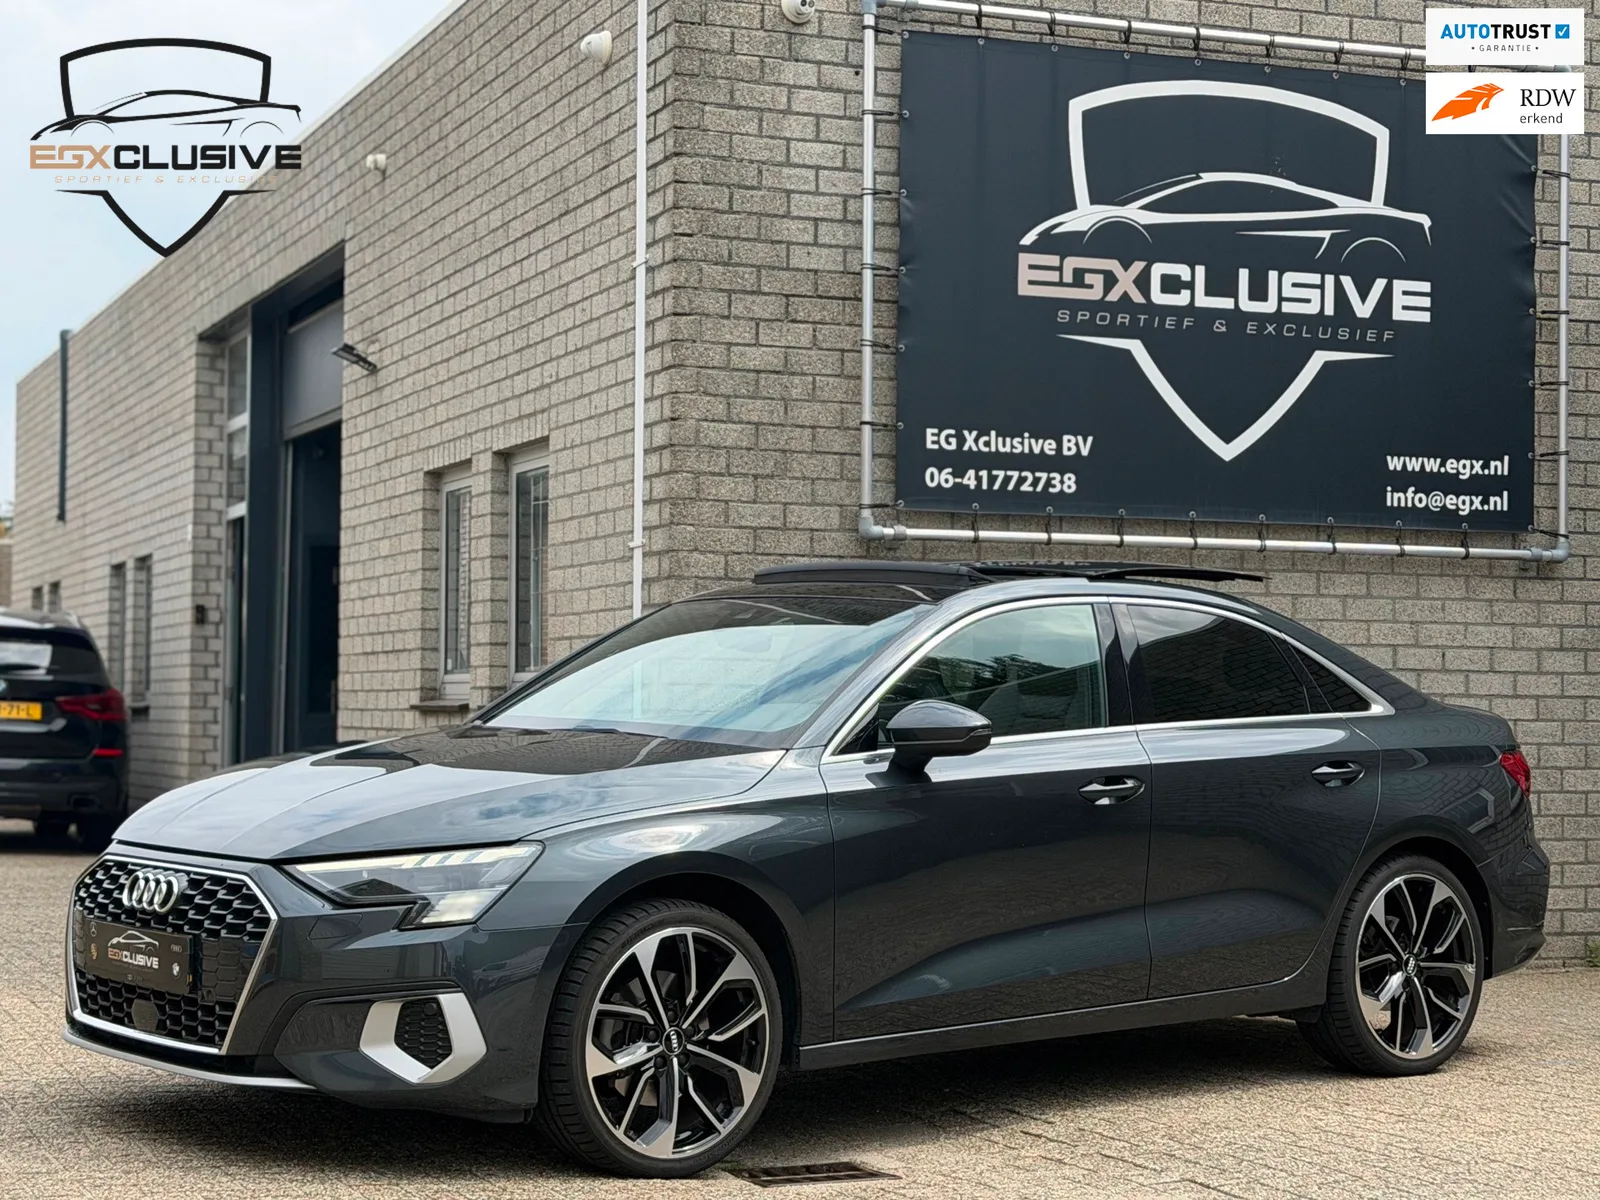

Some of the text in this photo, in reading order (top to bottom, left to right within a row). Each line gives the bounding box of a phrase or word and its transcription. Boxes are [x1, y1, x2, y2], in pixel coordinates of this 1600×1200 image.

[1017, 252, 1432, 323] EGXCLUSIVE
[1056, 309, 1396, 343] SPORTIEF & EXCLUSIEF
[925, 428, 1093, 457] EG Xclusive BV
[925, 466, 1077, 493] 06-41772738
[1386, 455, 1509, 480] www.egx.nl
[1386, 486, 1508, 516] info@egx.nl
